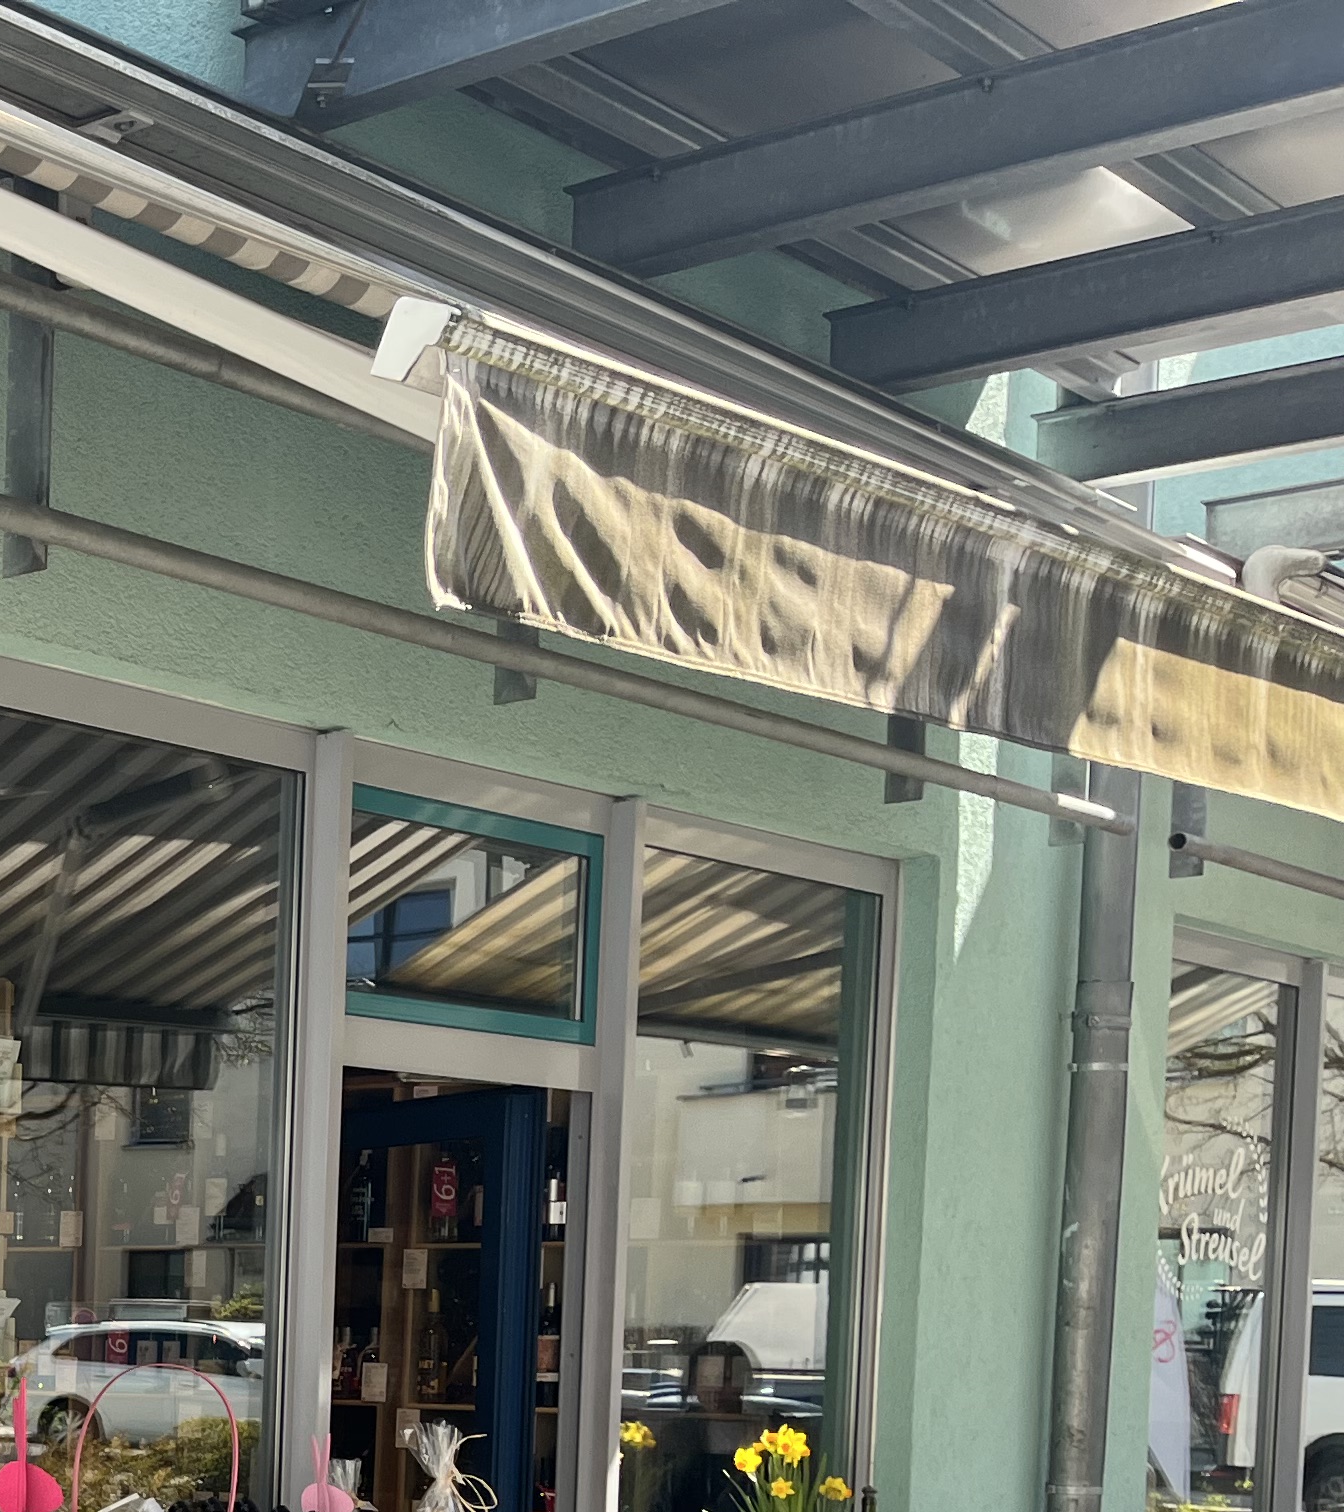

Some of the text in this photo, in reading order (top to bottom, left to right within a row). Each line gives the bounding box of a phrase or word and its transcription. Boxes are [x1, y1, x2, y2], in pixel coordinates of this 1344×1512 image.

[433, 1164, 457, 1201] 6+1
[1213, 1198, 1246, 1233] und
[1177, 1212, 1268, 1281] Streusel
